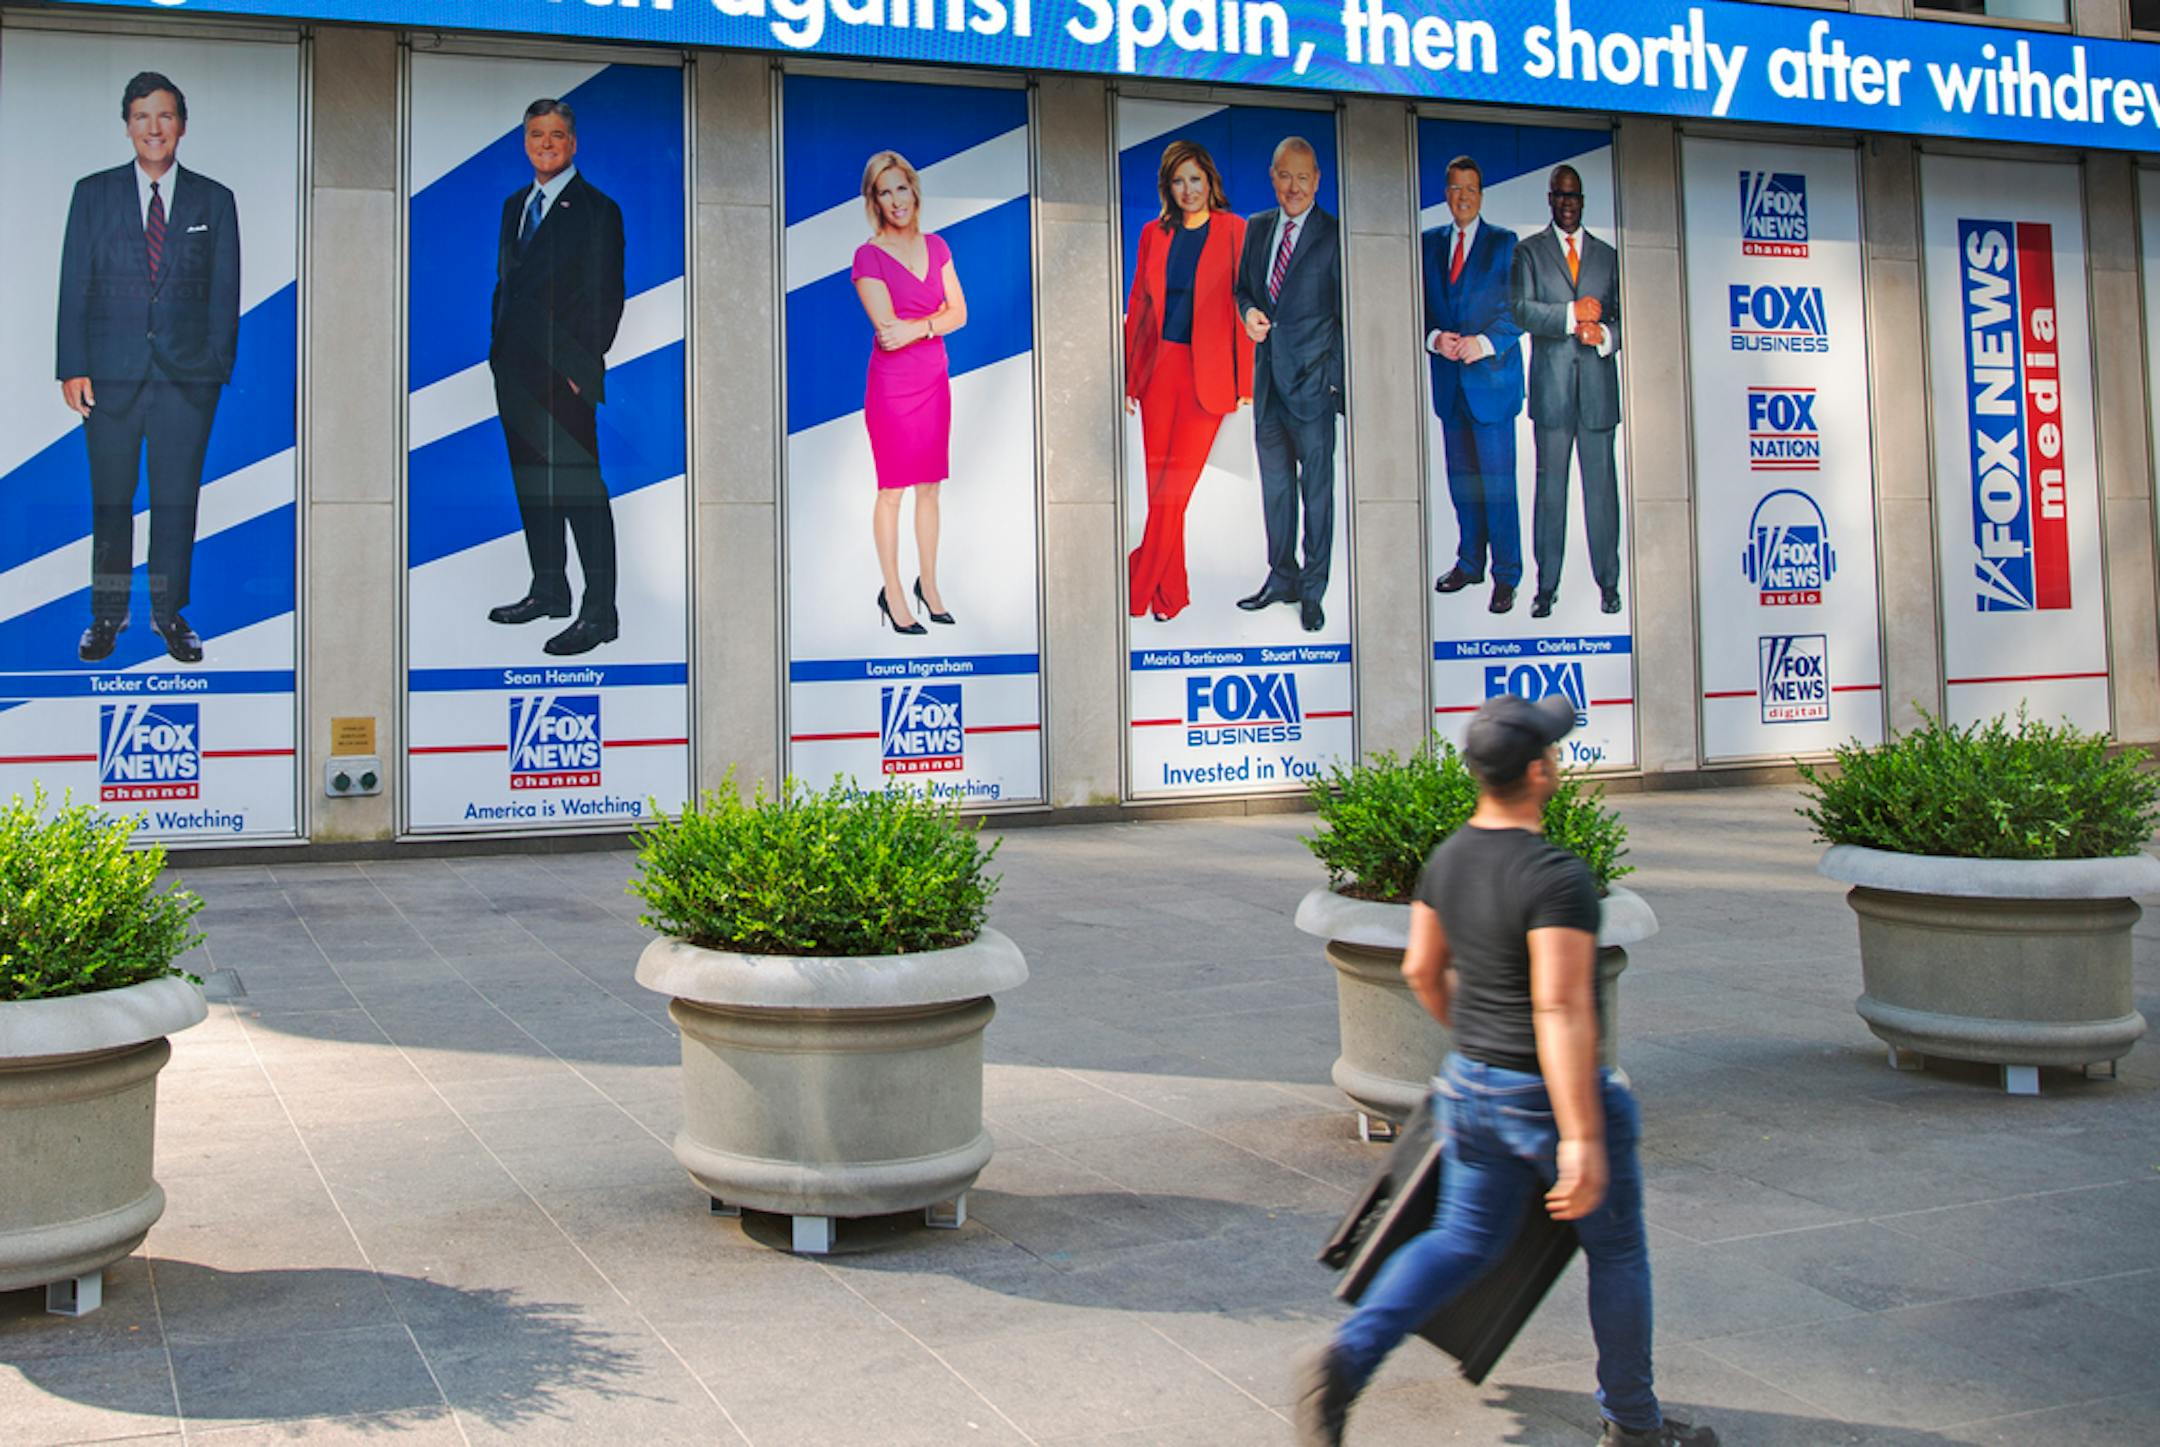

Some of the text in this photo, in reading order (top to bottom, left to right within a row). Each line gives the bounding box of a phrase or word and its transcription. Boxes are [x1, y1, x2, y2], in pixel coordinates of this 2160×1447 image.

[1065, 0, 1316, 75] Spain,
[1340, 0, 1499, 74] then
[1523, 0, 1749, 117] shortly
[1768, 19, 1912, 107] after
[1763, 191, 1805, 216] FOX
[1751, 216, 1807, 240] NEWS
[1744, 243, 1808, 257] channel
[1729, 284, 1812, 330] FOX
[1731, 335, 1829, 353] BUSINESS
[1965, 227, 2025, 559] FOX NEWS
[1748, 394, 1818, 431] FOX
[2026, 306, 2065, 520] media
[1750, 440, 1820, 457] NATION
[1779, 543, 1818, 566] FOX
[1768, 566, 1820, 588] NEWS
[1764, 591, 1818, 605] audio
[1260, 648, 1341, 662] Stuart Varney
[1456, 642, 1522, 656] Neil Cavuto
[1536, 638, 1612, 653] Charles Payne
[866, 658, 973, 677] Laura Ingraham
[1142, 650, 1244, 666] Maria Bartiromo
[1783, 656, 1822, 678] FOX
[90, 674, 209, 691] Tucker Carlson
[503, 668, 604, 685] Sean Hannity
[1485, 663, 1573, 704] FOX
[1186, 674, 1286, 723] FOX
[1772, 680, 1824, 701] NEWS
[908, 702, 960, 729] FOX
[1769, 705, 1823, 720] digital
[132, 723, 196, 752] FOX
[539, 714, 597, 742] FOX
[1187, 725, 1302, 746] BUSINESS
[893, 729, 962, 754] NEWS
[1569, 741, 1606, 762] You.
[114, 752, 198, 780] NEWS
[522, 742, 599, 768] NEWS
[885, 758, 962, 772] channel
[513, 773, 599, 788] channel
[1163, 755, 1249, 784] Invested
[1256, 757, 1274, 778] in
[102, 784, 198, 800] channel
[464, 795, 642, 819] America is Watching
[155, 808, 244, 832] Watching
